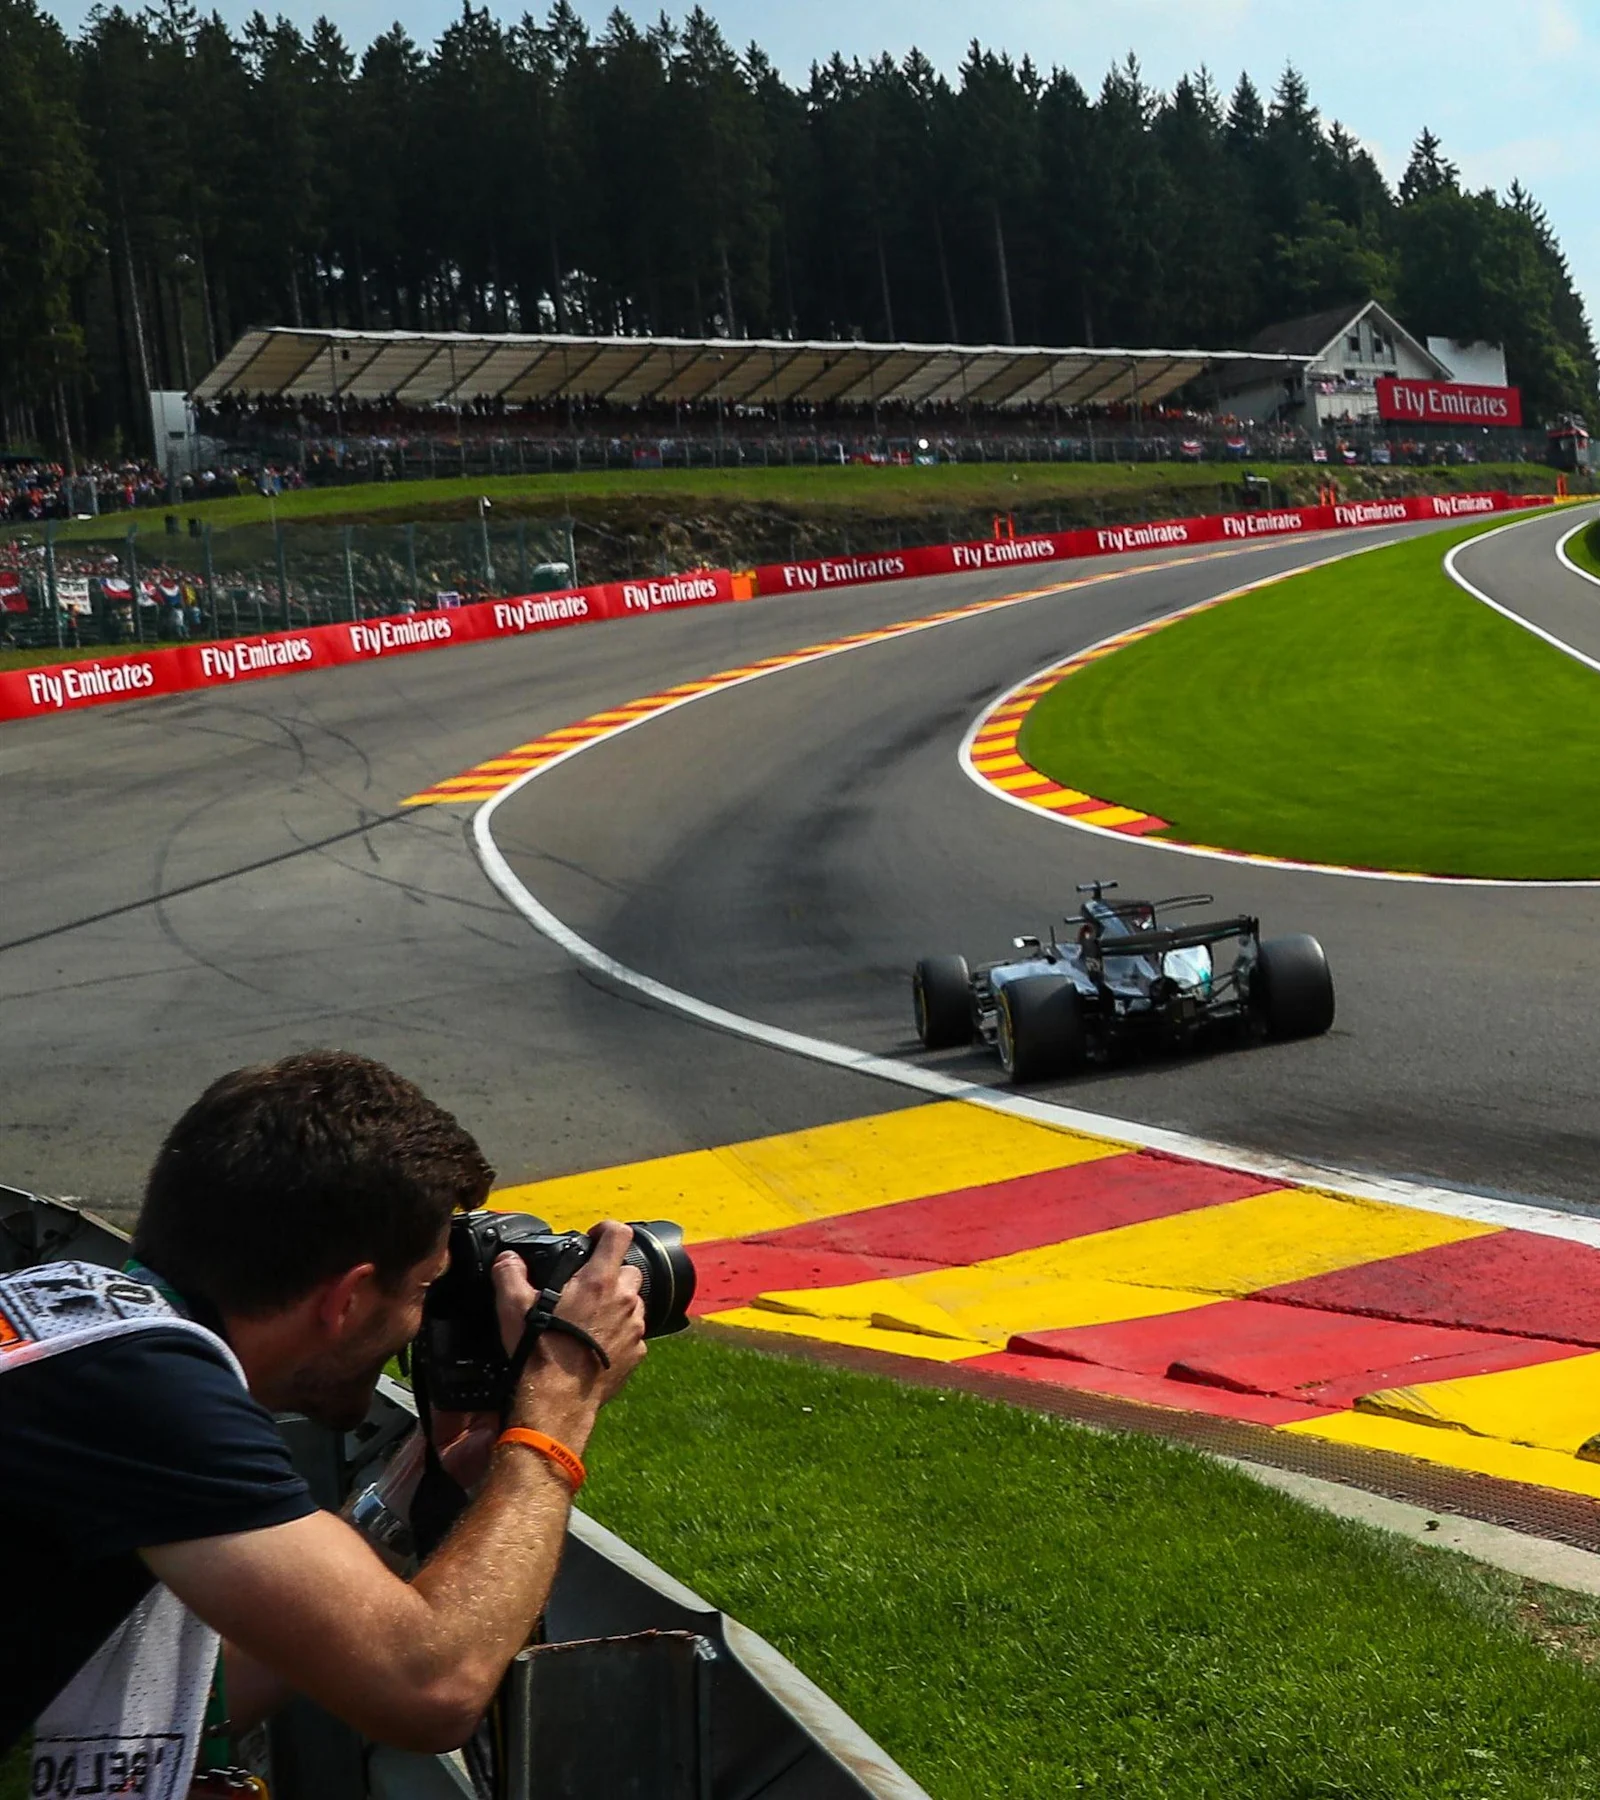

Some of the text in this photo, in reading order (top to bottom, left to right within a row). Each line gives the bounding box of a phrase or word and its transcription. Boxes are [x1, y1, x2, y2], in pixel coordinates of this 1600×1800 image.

[1393, 386, 1508, 417] Fly Emirates
[1223, 512, 1302, 537] Fly Emirates
[1334, 502, 1407, 525] Fly Emirates
[1097, 524, 1188, 551] Fly Emirates
[953, 540, 1055, 567] Fly Emirates
[784, 557, 904, 588] Fly Emirates
[623, 579, 717, 611] Fly Emirates
[494, 596, 588, 630] Fly Emirates
[349, 617, 451, 655] Fly Emirates
[201, 638, 312, 679] Fly Emirates
[27, 663, 153, 707] Fly Emirates
